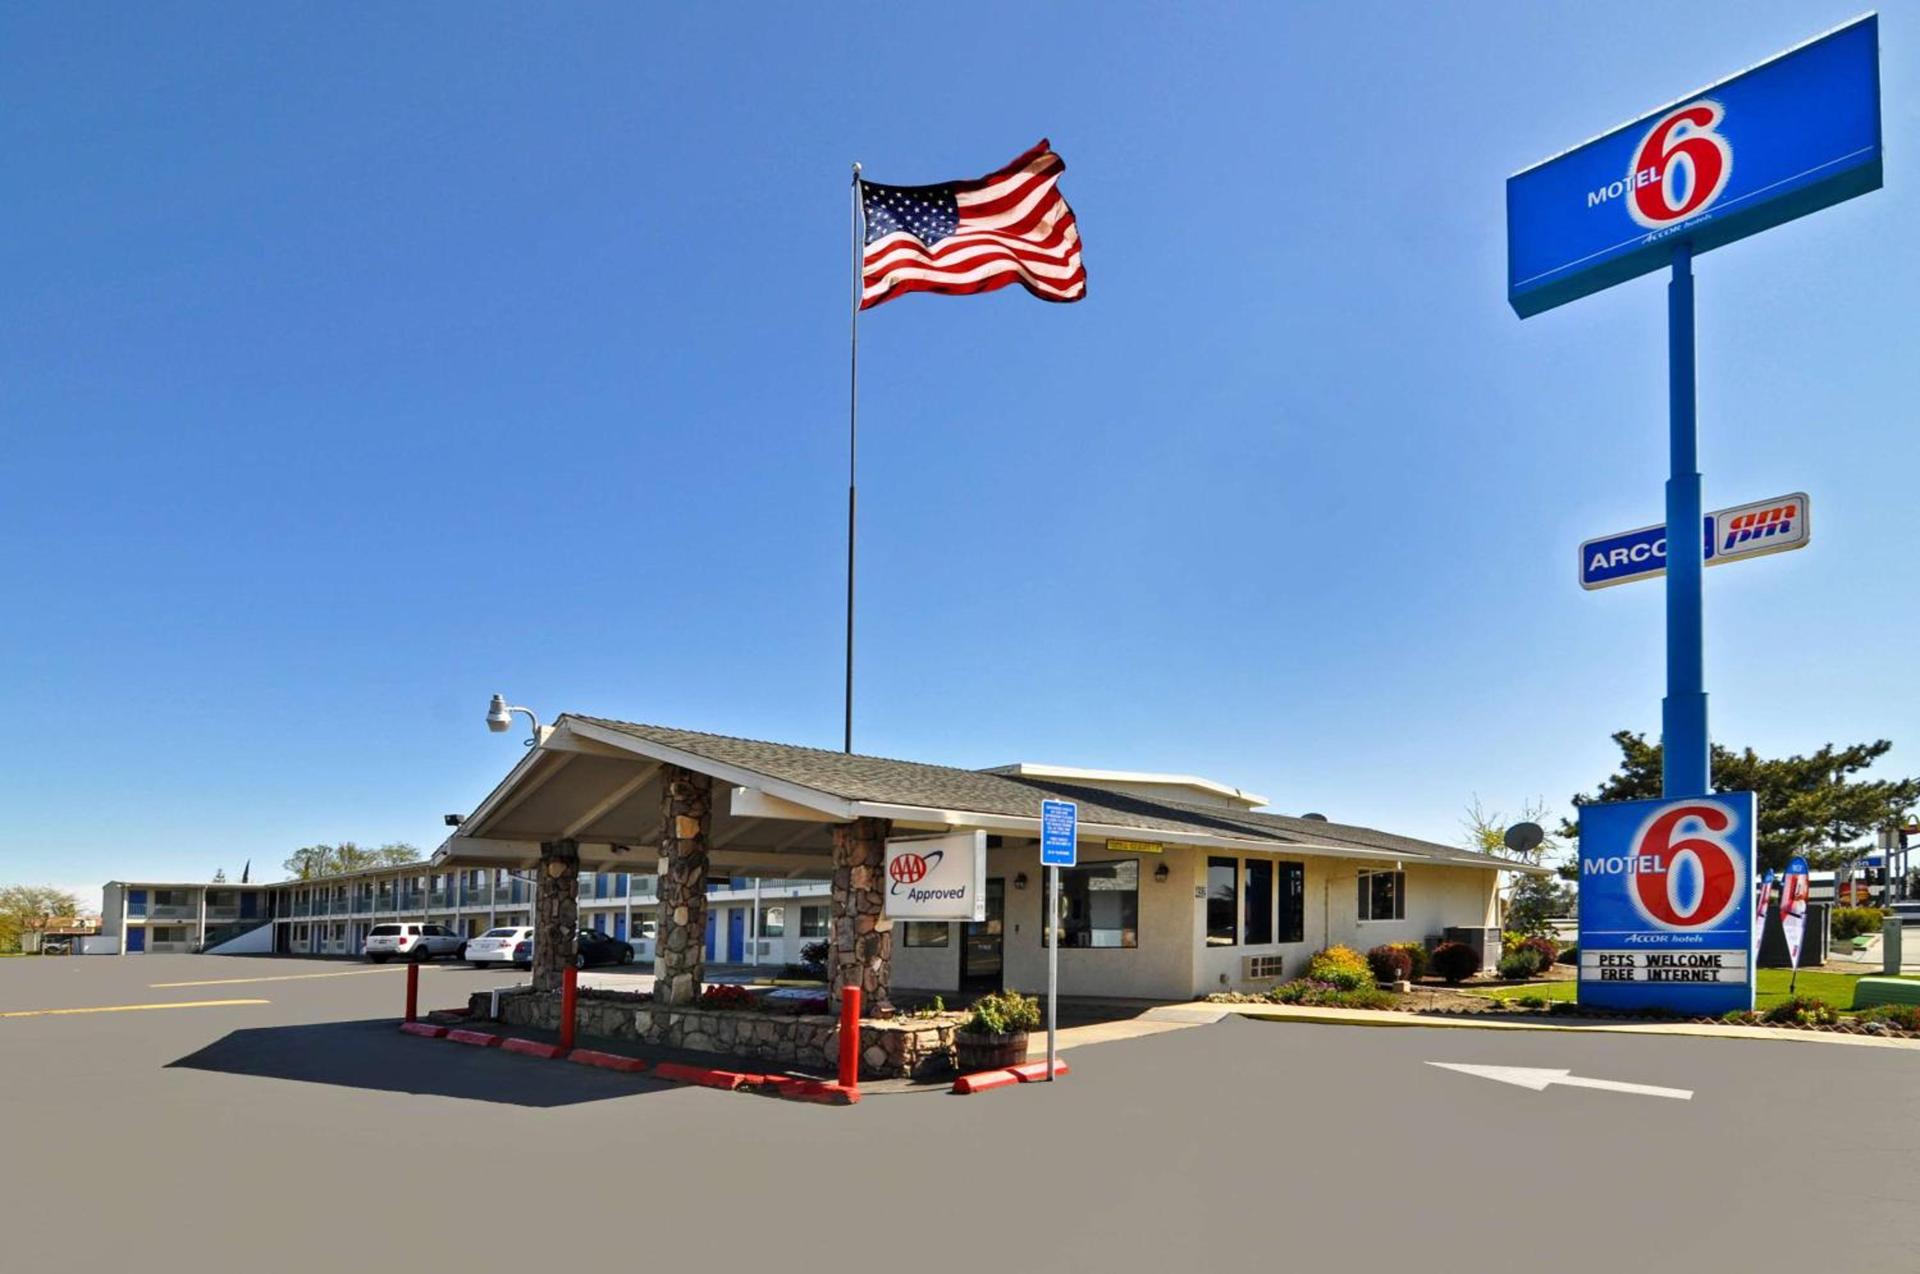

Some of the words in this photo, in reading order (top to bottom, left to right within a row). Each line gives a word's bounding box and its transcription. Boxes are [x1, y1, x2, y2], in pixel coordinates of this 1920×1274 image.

[1587, 166, 1662, 208] MOTEL
[1631, 102, 1728, 225] 6
[891, 855, 924, 882] AAA
[1583, 855, 1666, 876] MOTEL
[1632, 803, 1740, 929] 6
[908, 885, 966, 903] Approved
[1599, 954, 1635, 967] PETS
[1643, 954, 1723, 968] WELCOME
[1600, 968, 1635, 981] FREE
[1646, 968, 1720, 982] INTERNET
